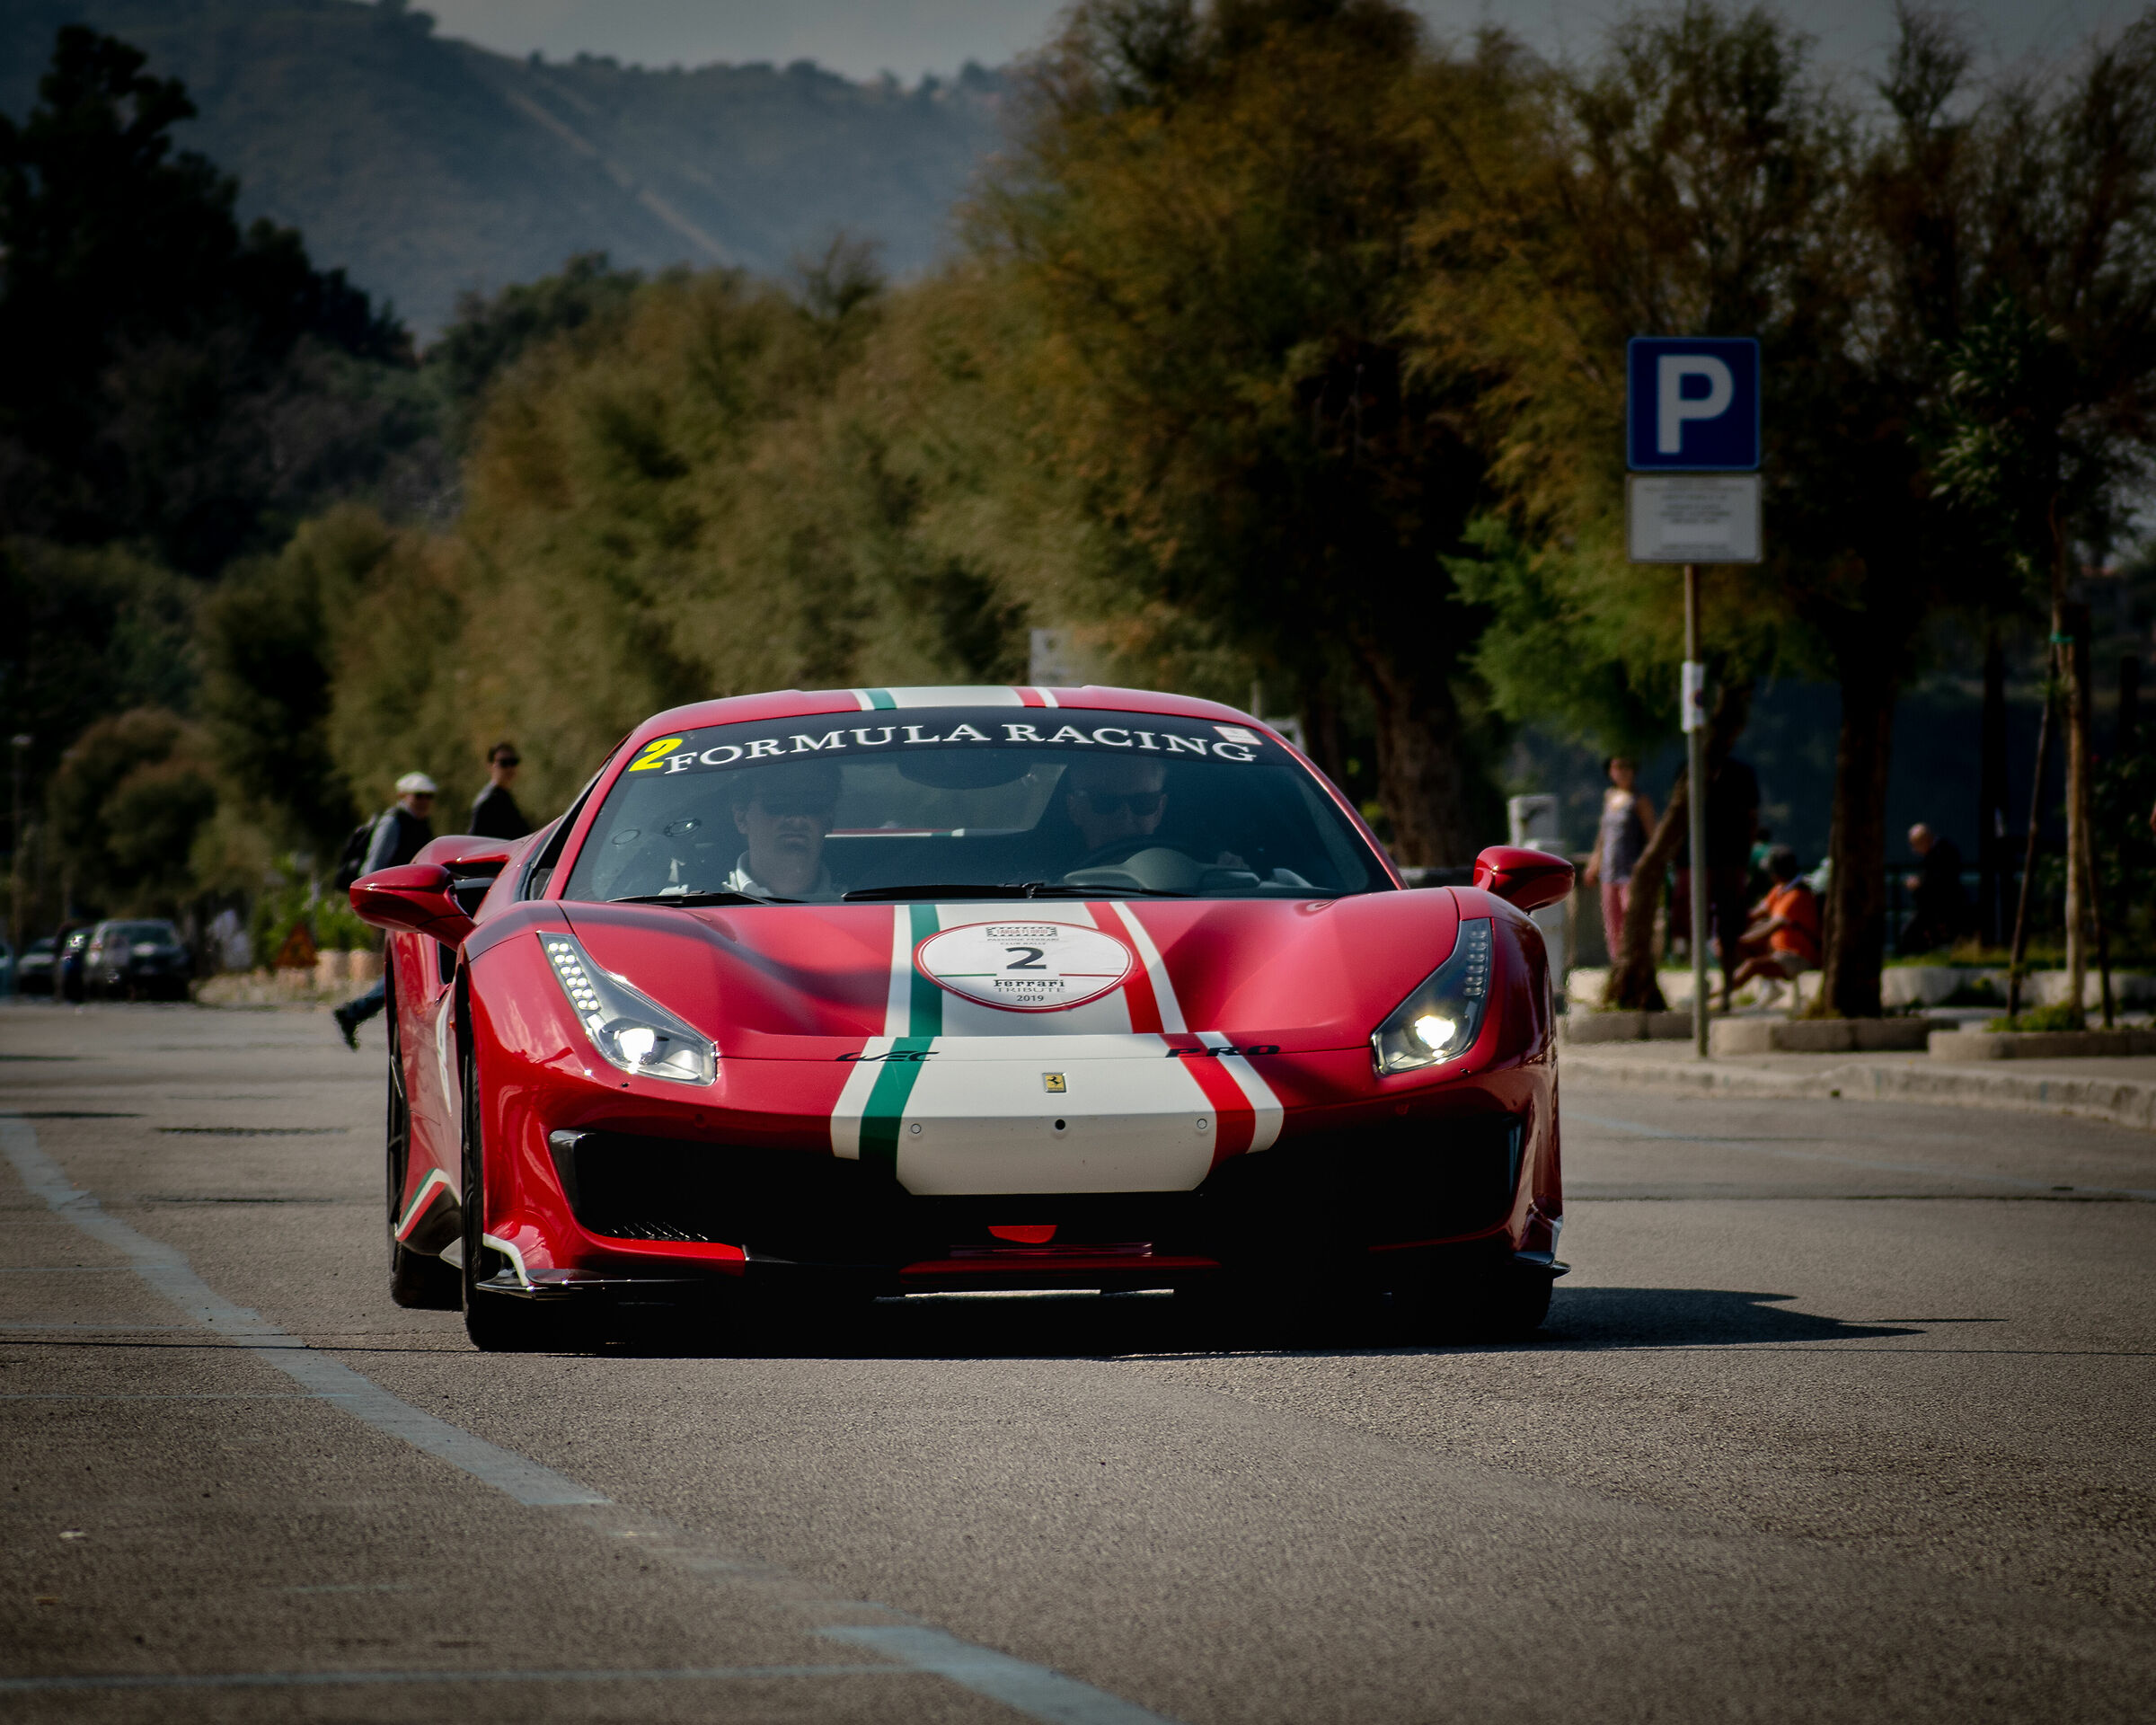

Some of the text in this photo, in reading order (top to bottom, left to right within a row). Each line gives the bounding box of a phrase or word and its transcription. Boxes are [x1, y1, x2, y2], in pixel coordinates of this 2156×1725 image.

[1657, 353, 1735, 454] P
[629, 738, 683, 772] 2
[664, 724, 1257, 774] FORMULA RACING
[1005, 946, 1047, 969] 2
[994, 979, 1065, 987] Ferrari
[1165, 1045, 1280, 1057] PRO
